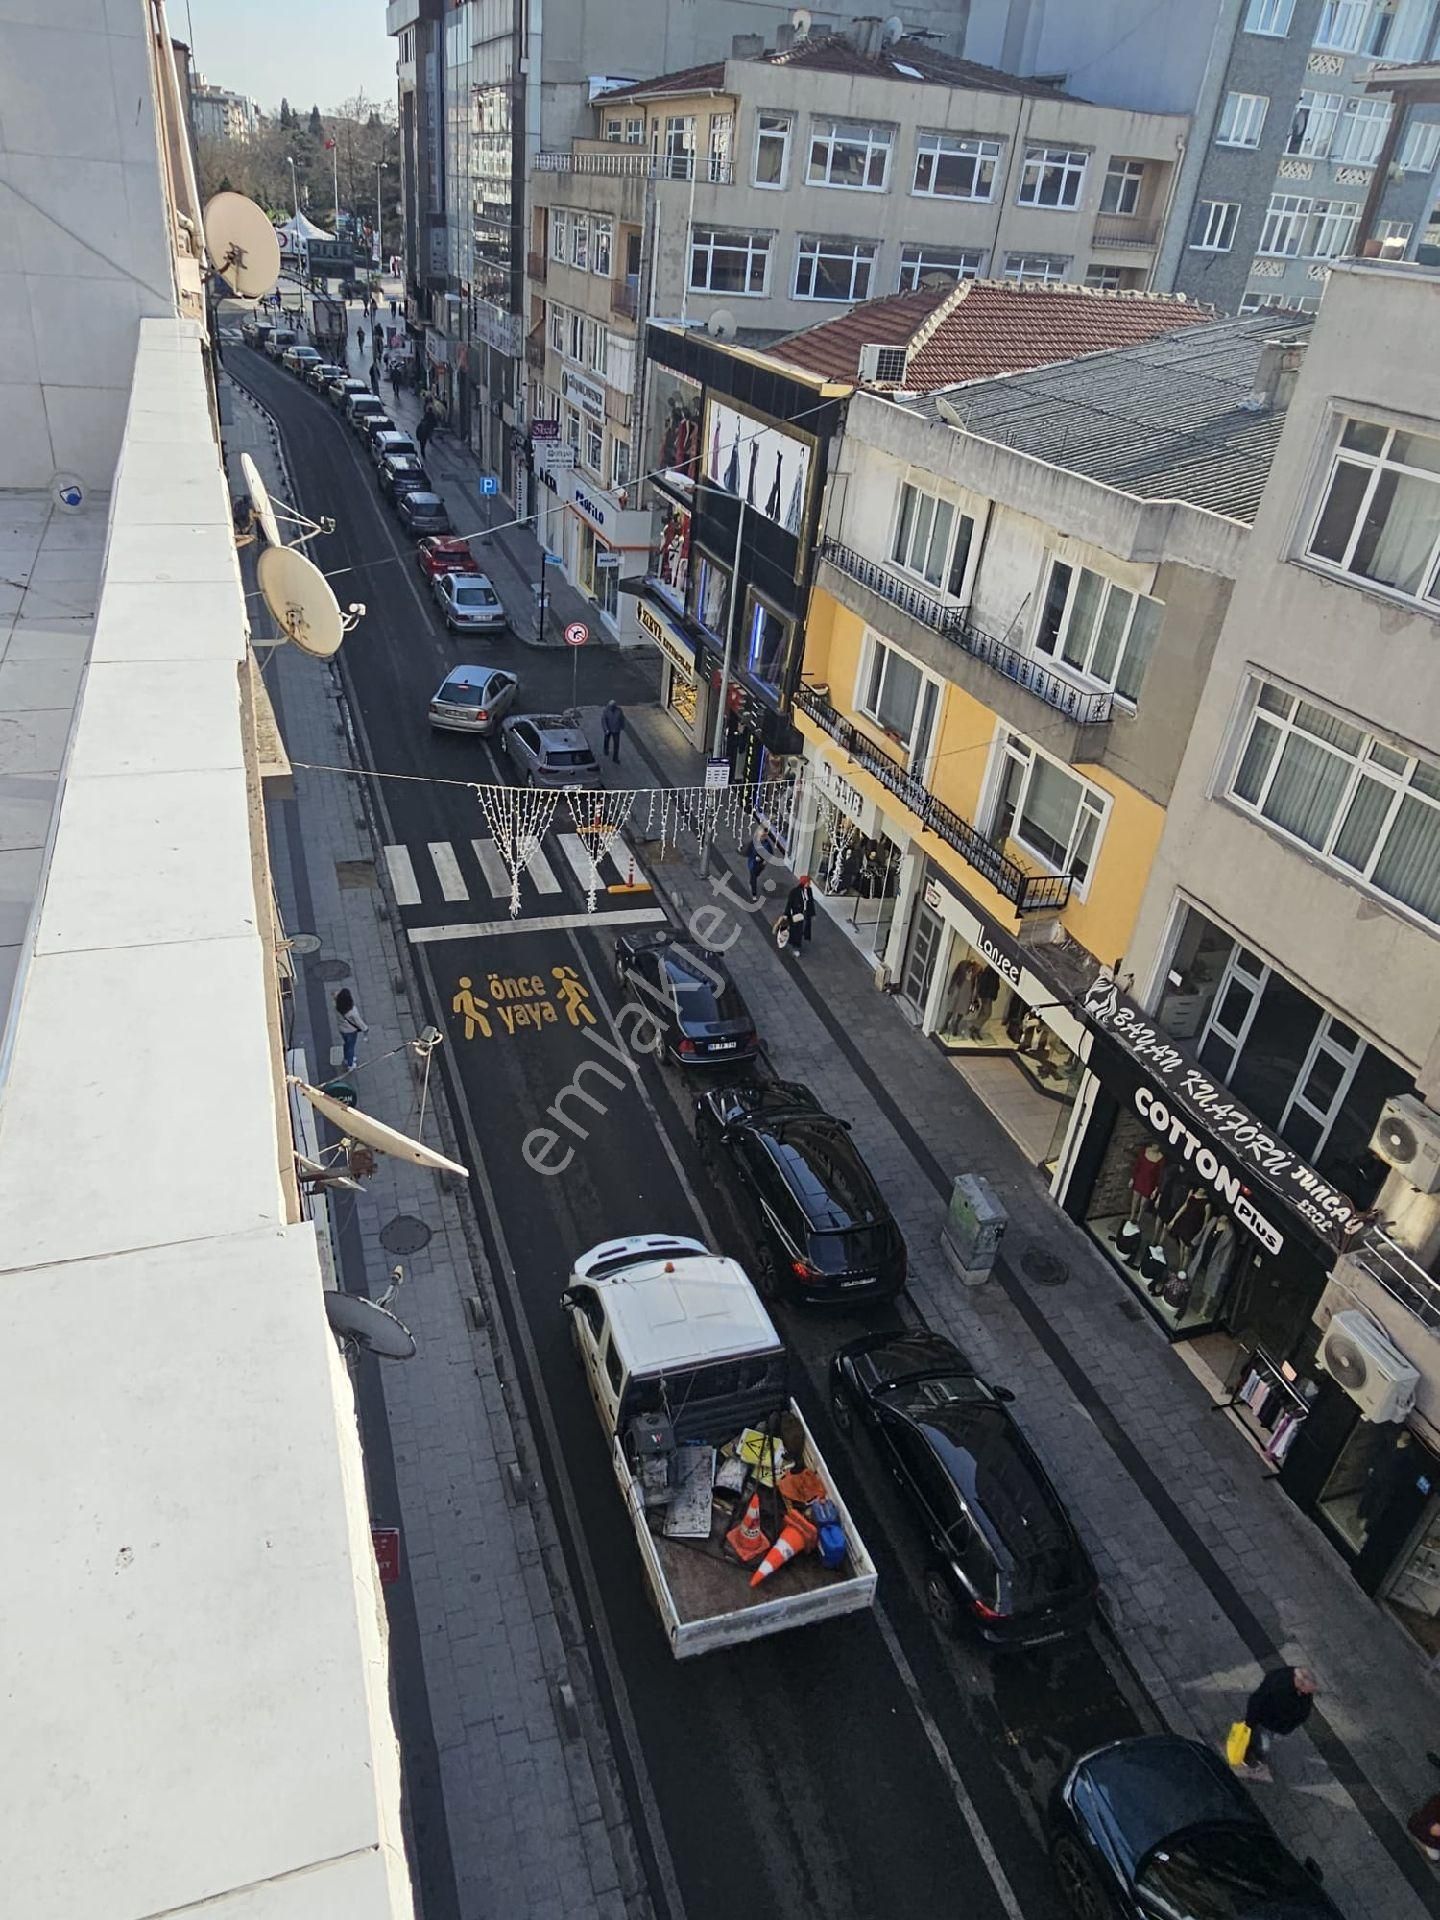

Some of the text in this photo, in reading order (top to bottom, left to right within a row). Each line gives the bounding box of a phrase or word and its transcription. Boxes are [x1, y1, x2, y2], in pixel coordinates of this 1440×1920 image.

[484, 479, 493, 493] P
[487, 973, 546, 1001] önce
[496, 1001, 558, 1035] yaya
[1112, 1007, 1184, 1073] BAYAN
[1179, 1068, 1295, 1177] KUAFÖRÜ
[1133, 1086, 1241, 1205] COTTON
